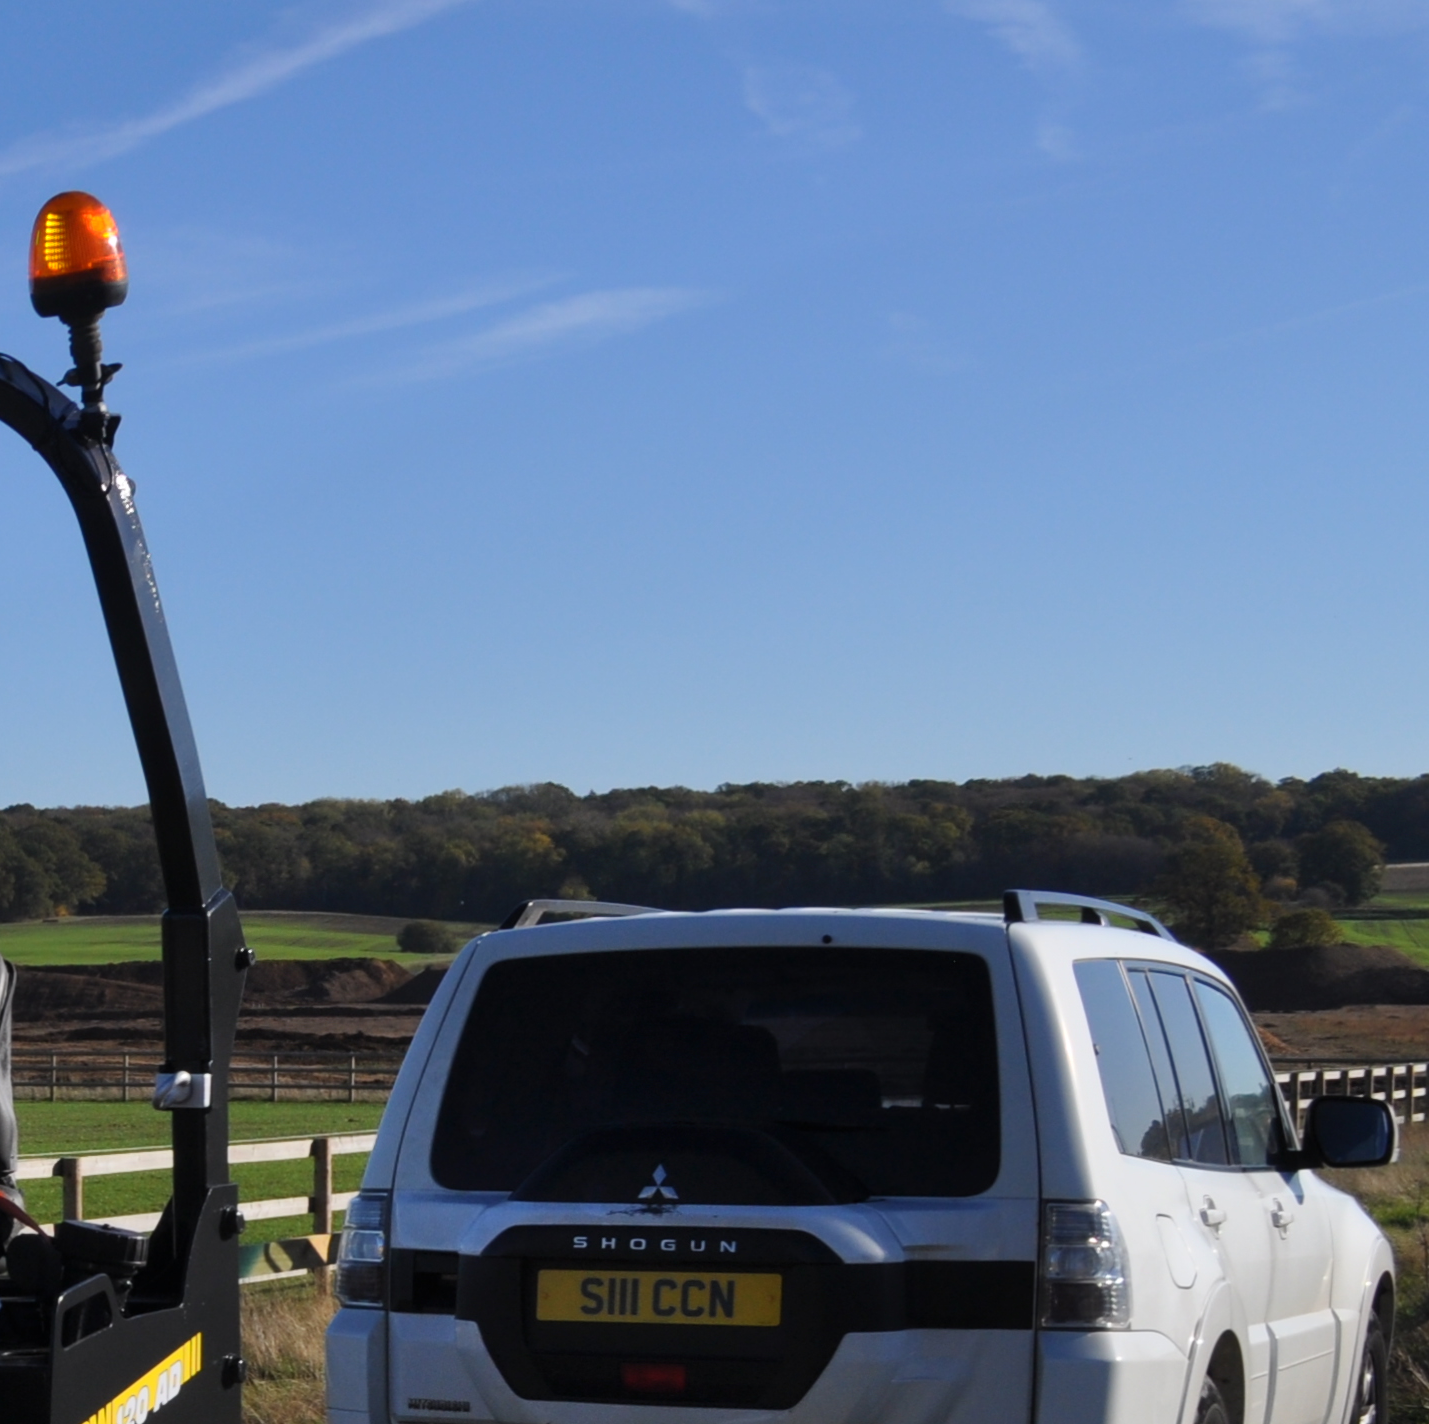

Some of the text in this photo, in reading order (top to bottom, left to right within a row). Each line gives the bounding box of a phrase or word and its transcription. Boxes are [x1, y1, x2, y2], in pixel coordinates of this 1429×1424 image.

[572, 1236, 737, 1253] SHOGUN
[652, 1278, 736, 1318] CCN
[153, 1359, 182, 1413] AD
